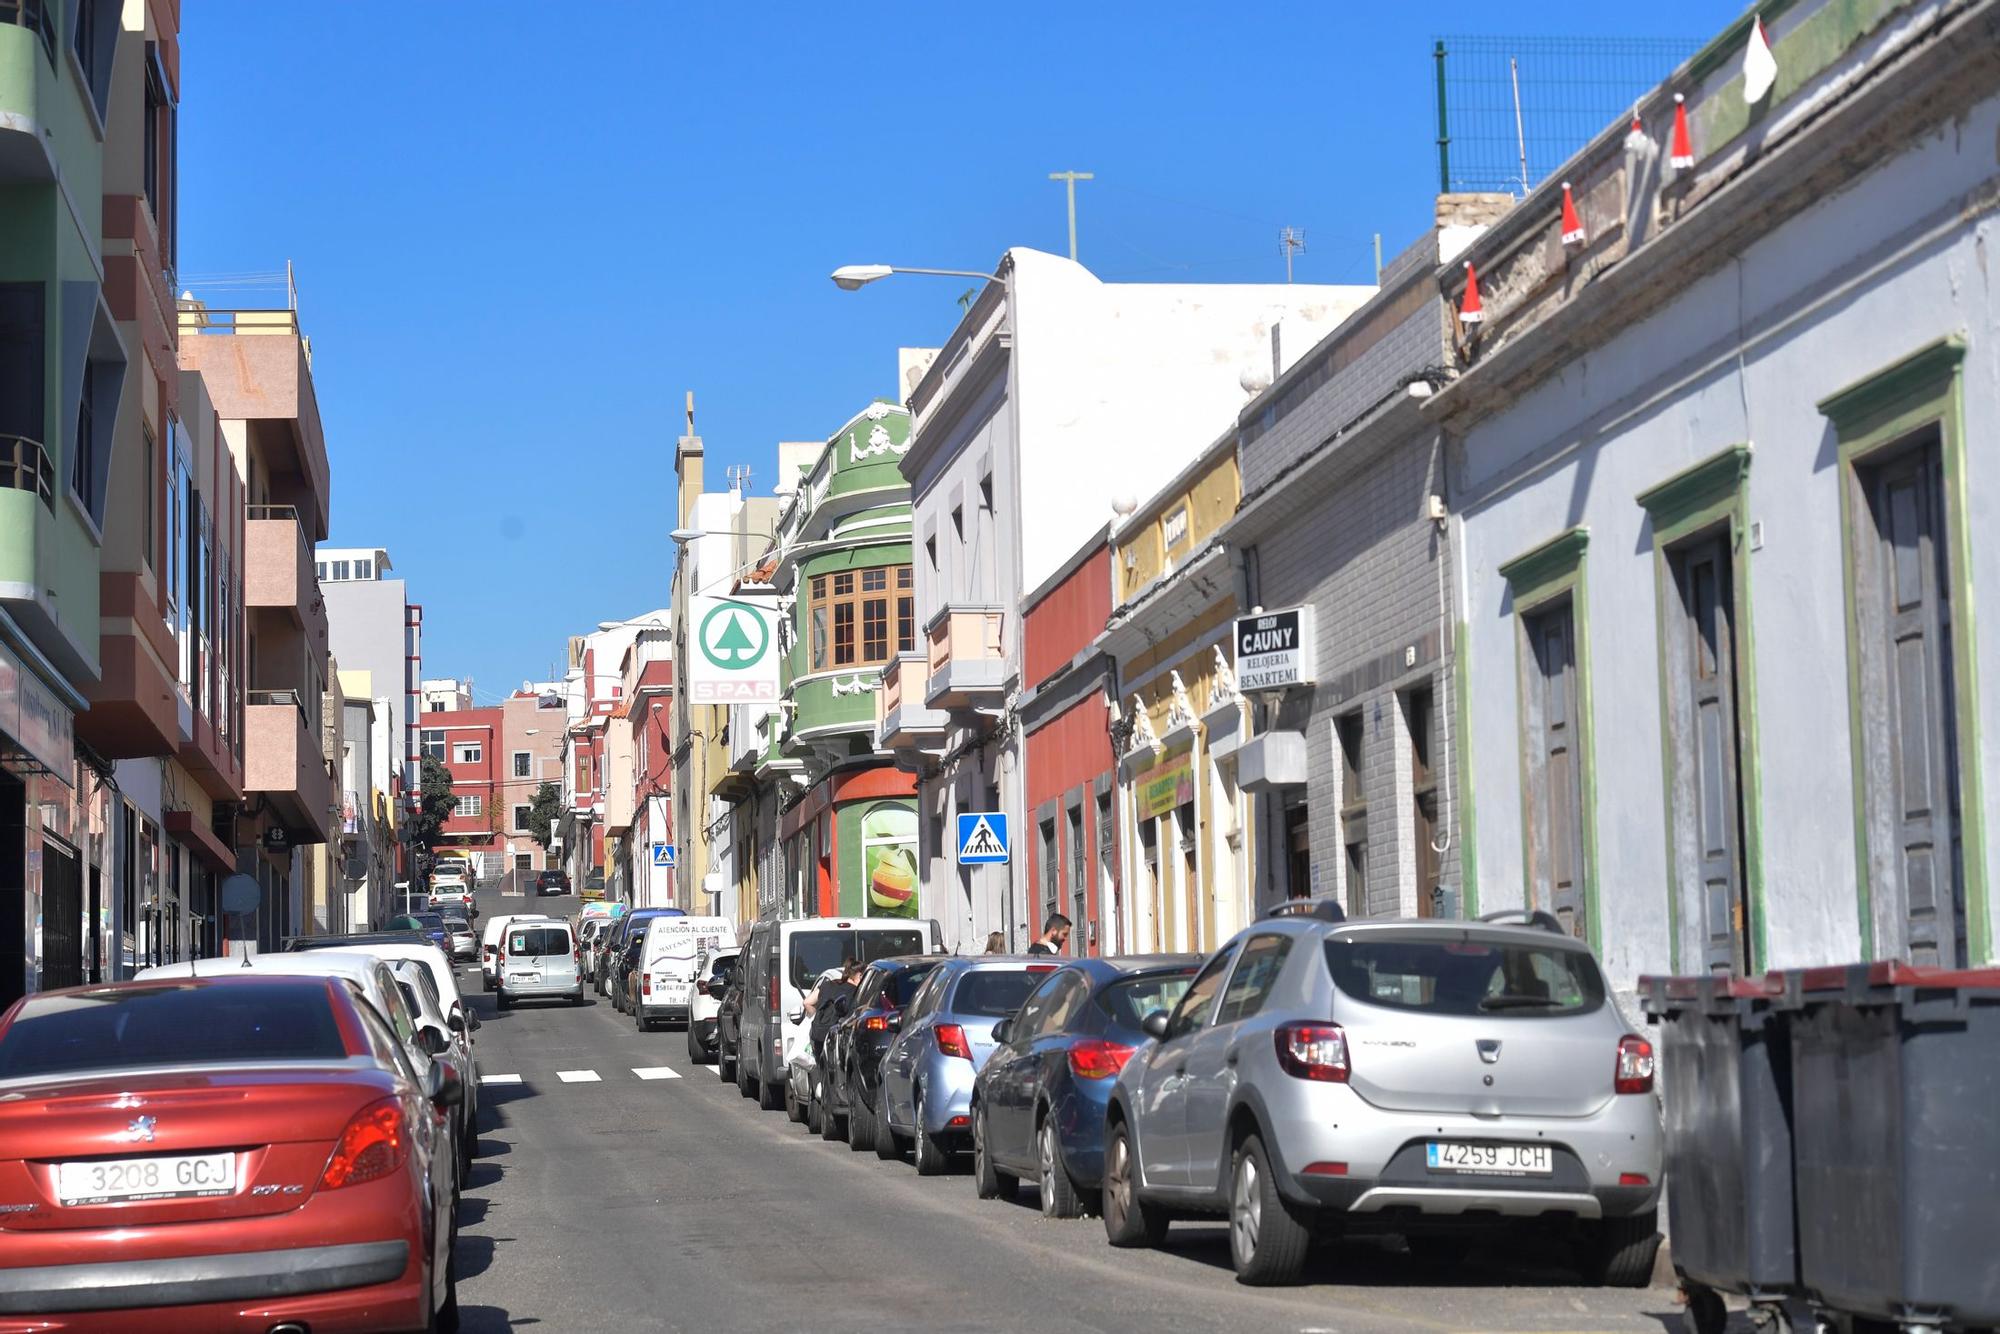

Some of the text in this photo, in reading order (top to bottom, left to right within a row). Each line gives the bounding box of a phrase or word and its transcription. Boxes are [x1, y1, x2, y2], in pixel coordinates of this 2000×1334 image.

[1242, 627, 1293, 654] CAUNY
[1240, 668, 1297, 688] BENARTEMI
[695, 682, 774, 698] SPAR
[691, 925, 700, 933] AL
[1443, 1144, 1546, 1167] 4259 JCH
[91, 1158, 228, 1191] 3208 GCJ
